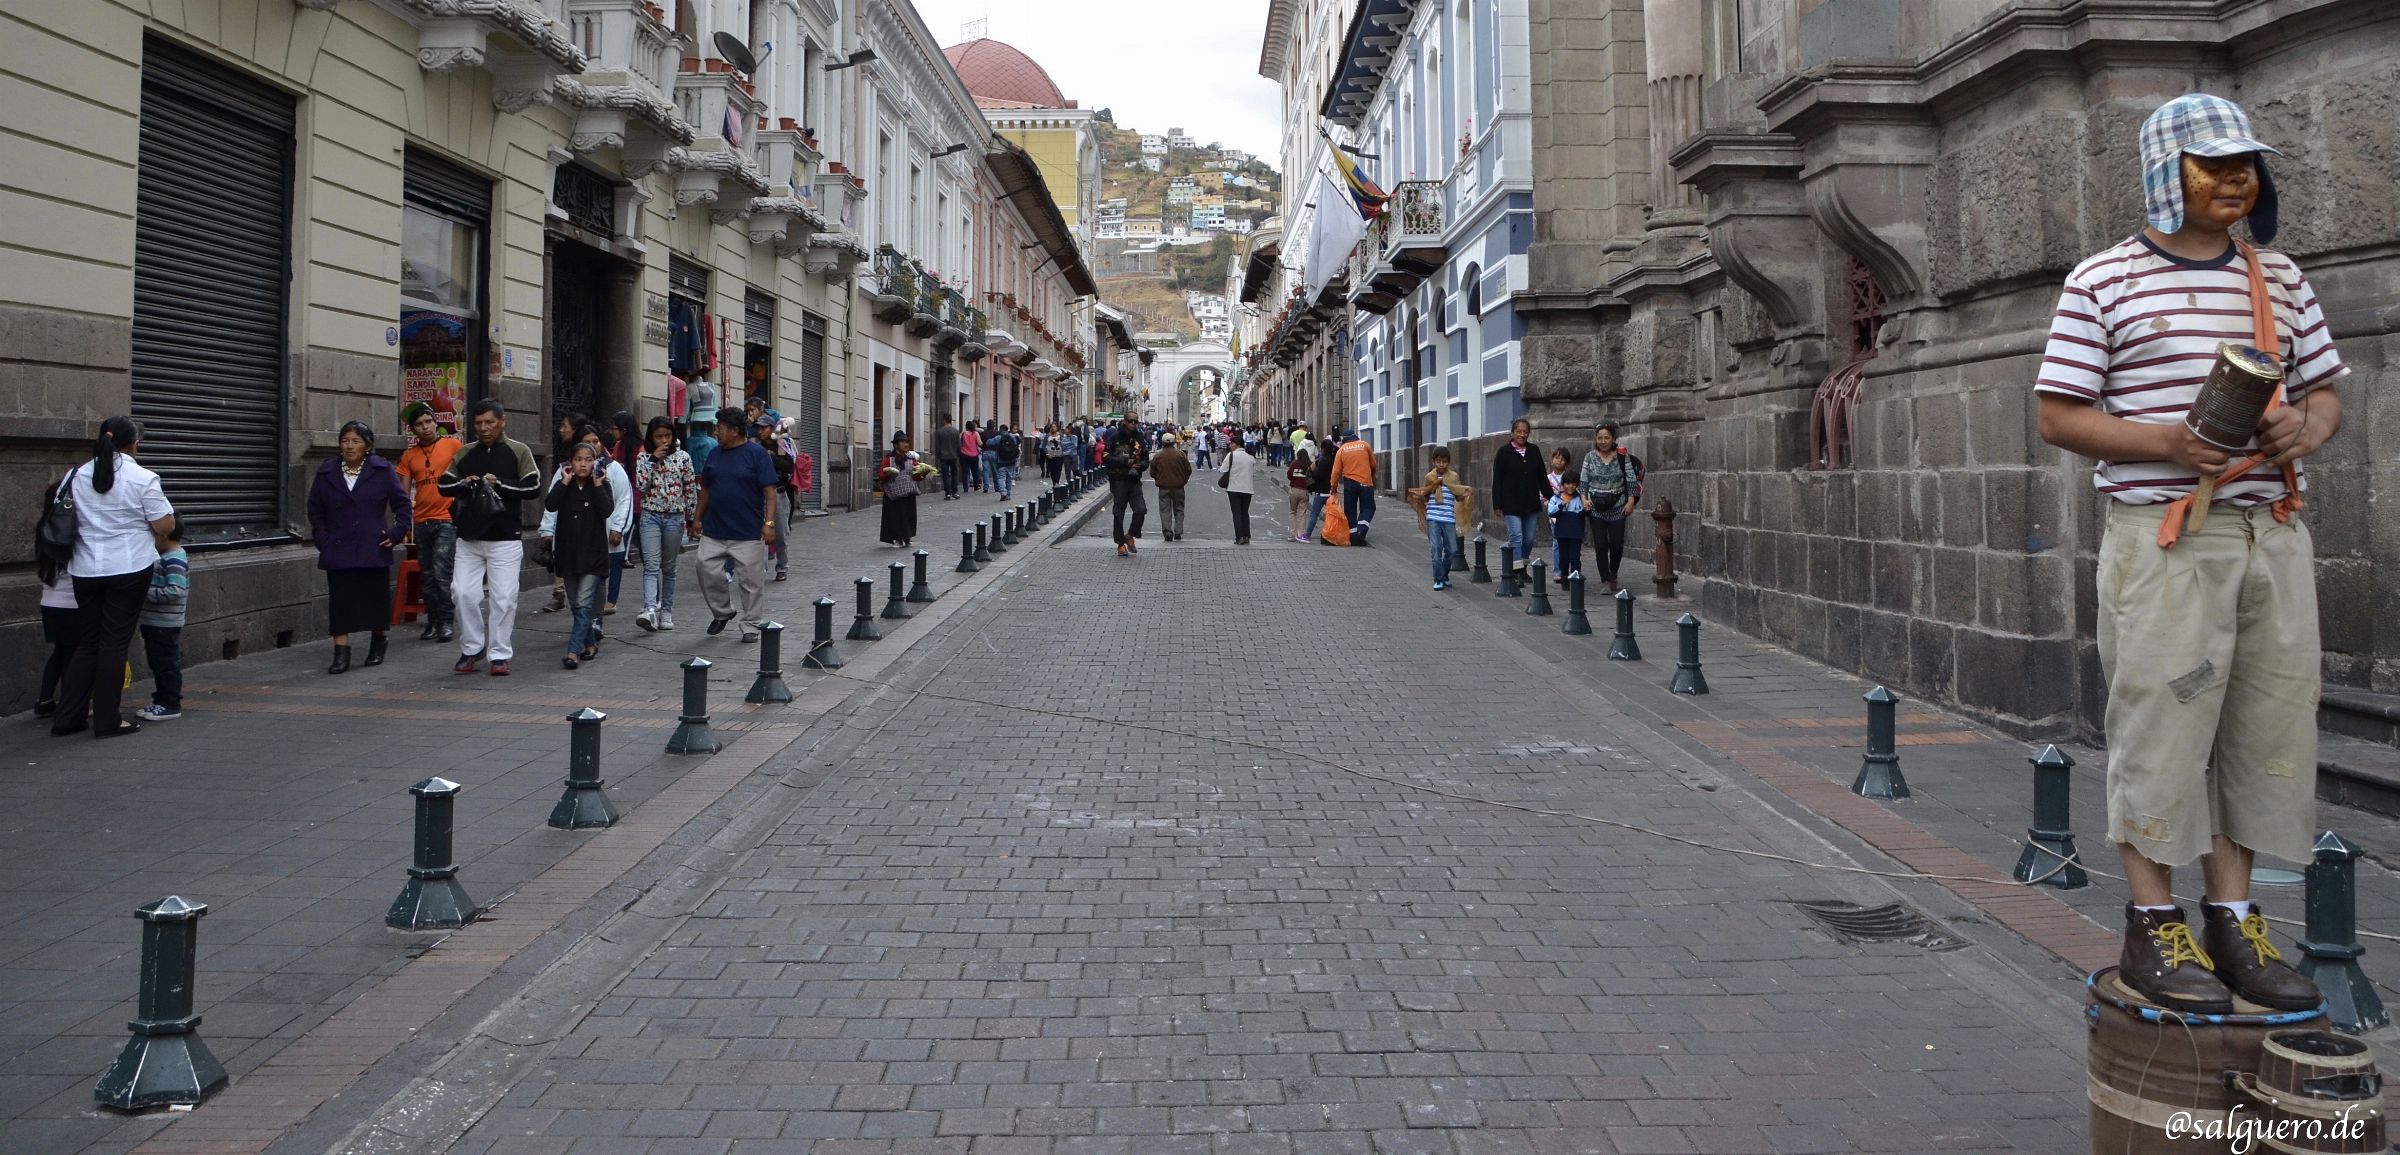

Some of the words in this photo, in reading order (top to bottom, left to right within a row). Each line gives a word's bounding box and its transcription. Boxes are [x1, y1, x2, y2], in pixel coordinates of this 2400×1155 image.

[406, 368, 443, 378] NARANJA
[407, 380, 436, 389] SANDIA
[407, 391, 432, 400] MELON
